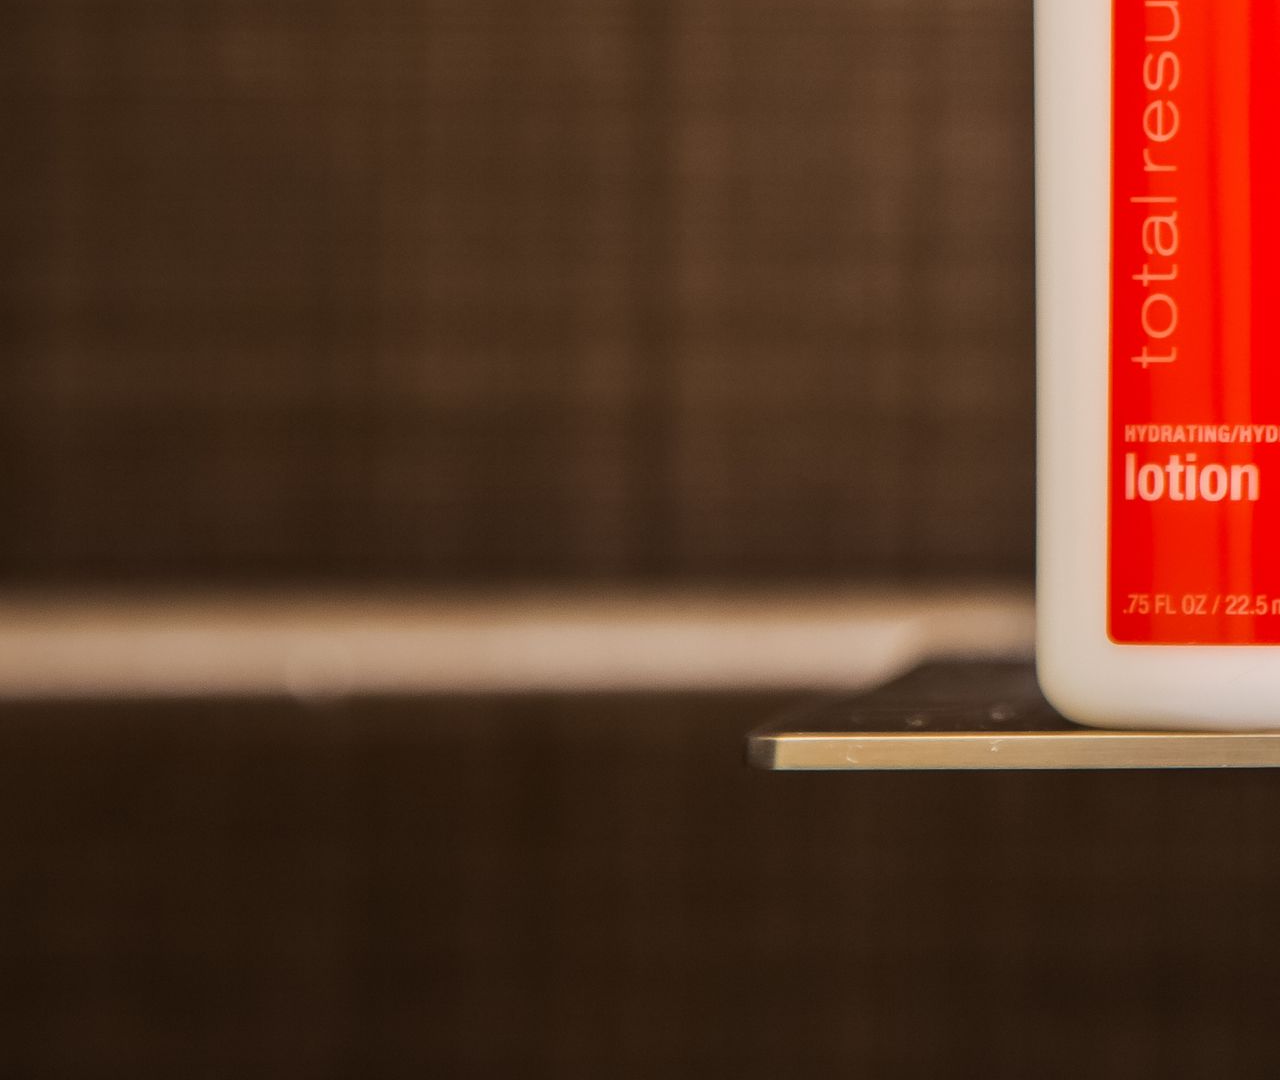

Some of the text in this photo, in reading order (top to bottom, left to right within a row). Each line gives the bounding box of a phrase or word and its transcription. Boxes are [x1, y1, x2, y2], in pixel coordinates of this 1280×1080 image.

[1130, 195, 1179, 369] total
[1125, 452, 1260, 502] lotion
[1123, 594, 1150, 614] .75
[1154, 594, 1177, 614] FL
[1181, 594, 1207, 615] OZ
[1225, 594, 1268, 615] 22.5
